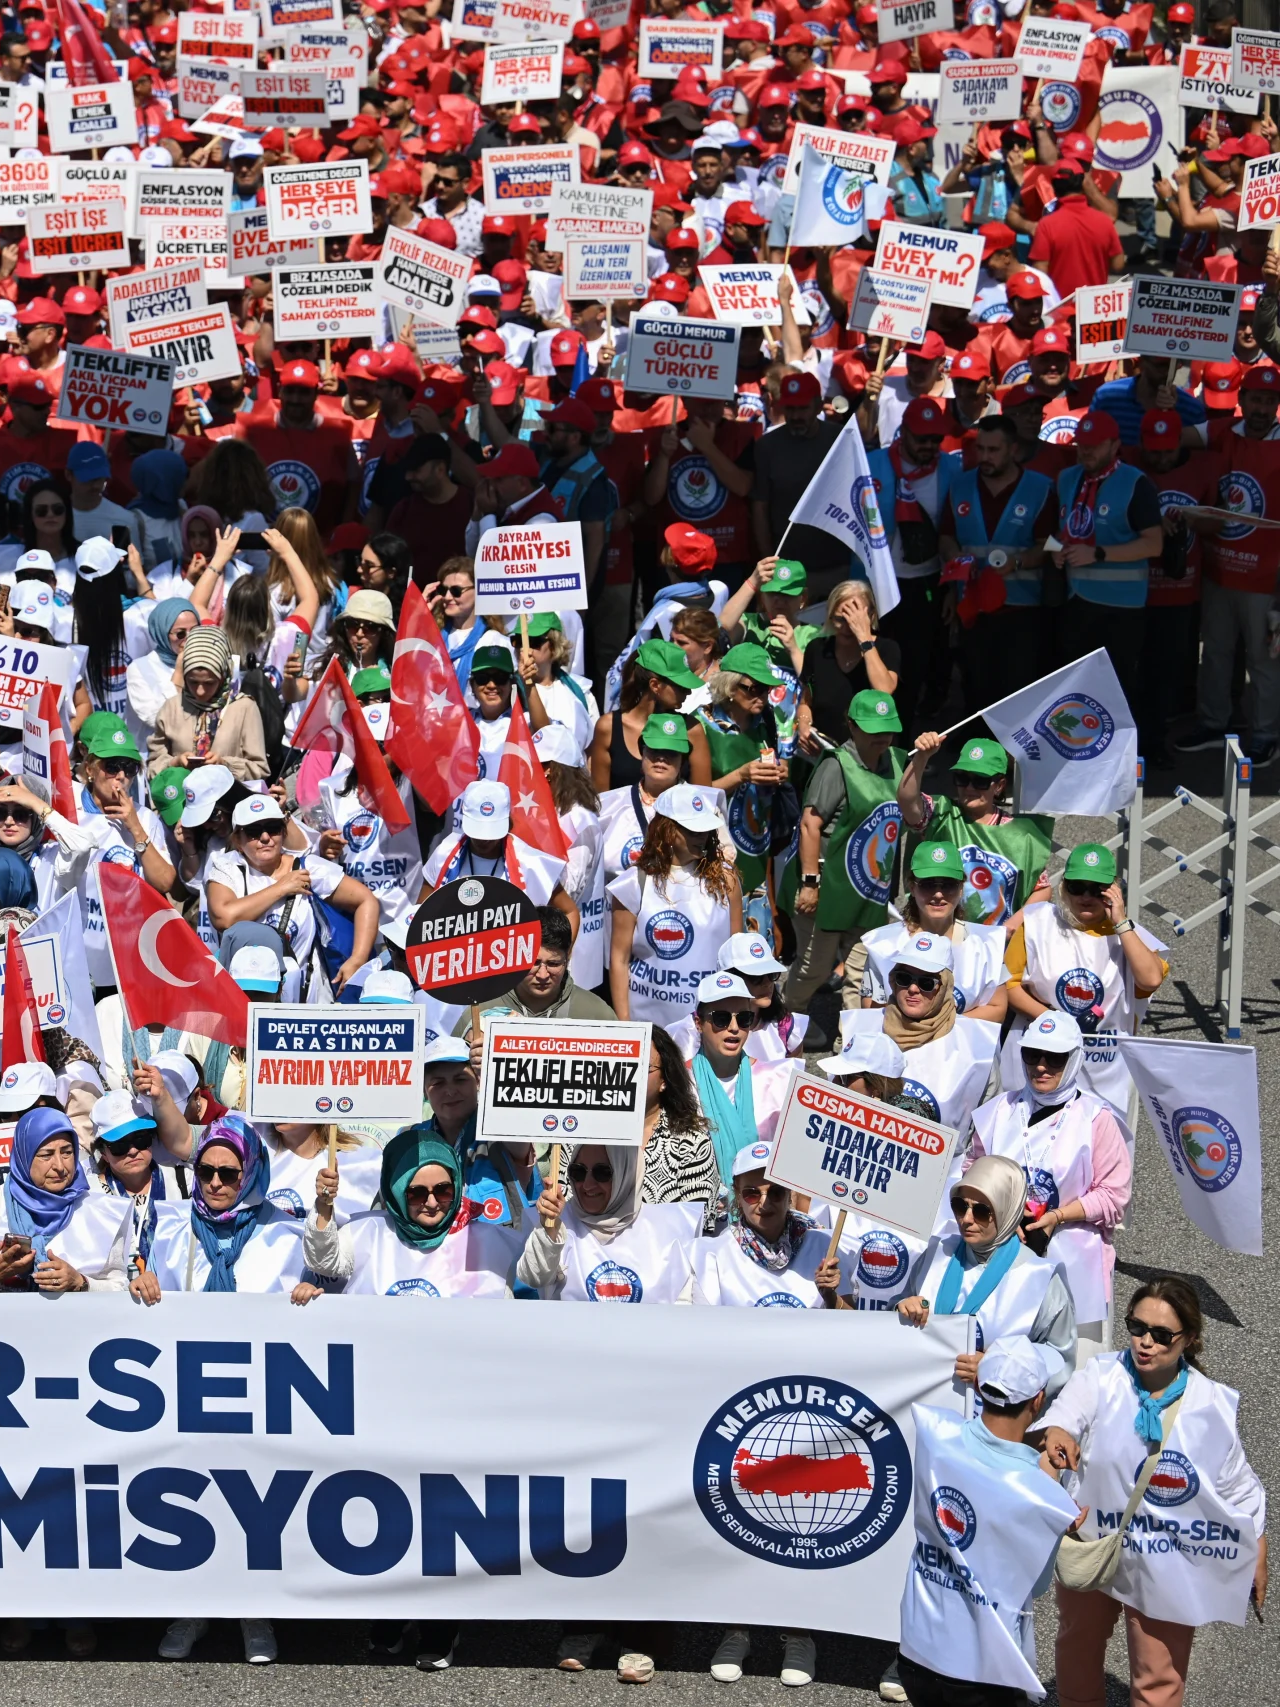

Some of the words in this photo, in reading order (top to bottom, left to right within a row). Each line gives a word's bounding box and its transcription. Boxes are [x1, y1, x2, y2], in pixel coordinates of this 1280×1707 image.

[894, 4, 937, 26] HAYIR
[1025, 29, 1081, 44] ENFLASYON
[947, 67, 979, 77] SUSMA
[981, 65, 1017, 76] HAYKIR
[953, 78, 1008, 94] SADAKAYA
[963, 90, 996, 106] HAYIR
[72, 119, 114, 131] ADALET
[0, 163, 49, 182] 3600
[328, 166, 361, 179] DEĞER
[143, 184, 223, 197] ENFLASYON
[280, 184, 312, 198] HER
[314, 180, 356, 197] ŞEYE
[281, 196, 358, 221] DEĞER
[898, 231, 959, 253] MEMUR
[421, 247, 465, 276] REZALET
[883, 243, 931, 266] ÜVEY
[583, 258, 605, 269] ALIN
[171, 268, 200, 284] ZAM
[309, 269, 362, 281] MASADA
[417, 263, 450, 285] NEREDE
[720, 271, 773, 283] MEMUR
[387, 270, 452, 306] ADALET
[714, 283, 758, 298] ÜVEY
[1174, 286, 1223, 301] MASADA
[719, 296, 768, 309] EVLAT
[281, 310, 321, 321] SAHAYI
[643, 321, 678, 336] GÜÇLÜ
[680, 325, 727, 339] MEMUR
[1132, 324, 1173, 338] SAHAYI
[653, 340, 713, 362] GÜÇLÜ
[69, 381, 126, 397] ADALET
[67, 392, 133, 426] YOK
[498, 530, 542, 544] BAYRAM
[479, 581, 504, 593] MEMUR
[505, 580, 545, 592] BAYRAM
[421, 913, 479, 943] REFAH
[483, 903, 521, 929] PAYI
[649, 911, 691, 930] MEMUR-SEN
[268, 1023, 317, 1036] DEVLET
[320, 1023, 405, 1037] ÇALIŞANLARI
[276, 1037, 397, 1051] ARASINDA
[258, 1059, 323, 1086] AYRIM
[329, 1059, 412, 1086] YAPMAZ
[498, 1087, 559, 1104] KABUL
[803, 1088, 867, 1127] SUSMA
[868, 1114, 942, 1155] HAYKIR
[1216, 1118, 1235, 1141] TOÇ
[806, 1114, 919, 1179] SADAKAYA
[821, 1153, 891, 1194] HAYIR
[714, 1384, 890, 1444] MEMUR-SEN
[707, 1462, 729, 1518] MEMUR
[813, 1464, 898, 1560] KONFEDERASYONU
[934, 1488, 975, 1524] MEMUR-SEN
[790, 1536, 819, 1549] 1995
